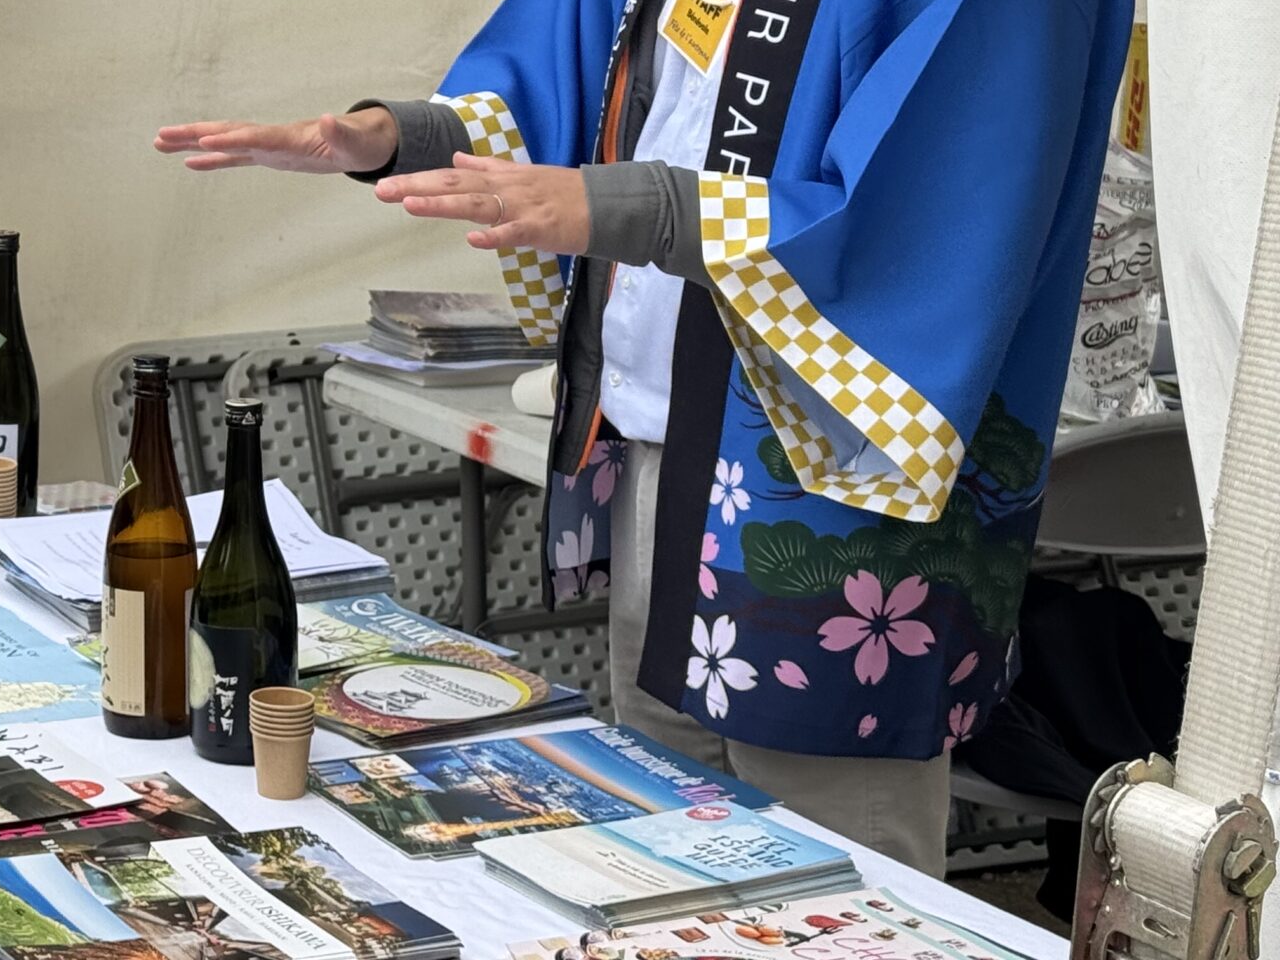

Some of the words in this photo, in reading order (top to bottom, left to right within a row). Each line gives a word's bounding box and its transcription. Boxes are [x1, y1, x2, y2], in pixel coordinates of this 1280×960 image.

[694, 843, 761, 870] GUIDE
[708, 835, 793, 868] ISLAND
[744, 835, 796, 855] IKI
[256, 905, 327, 951] ISHIKAWA
